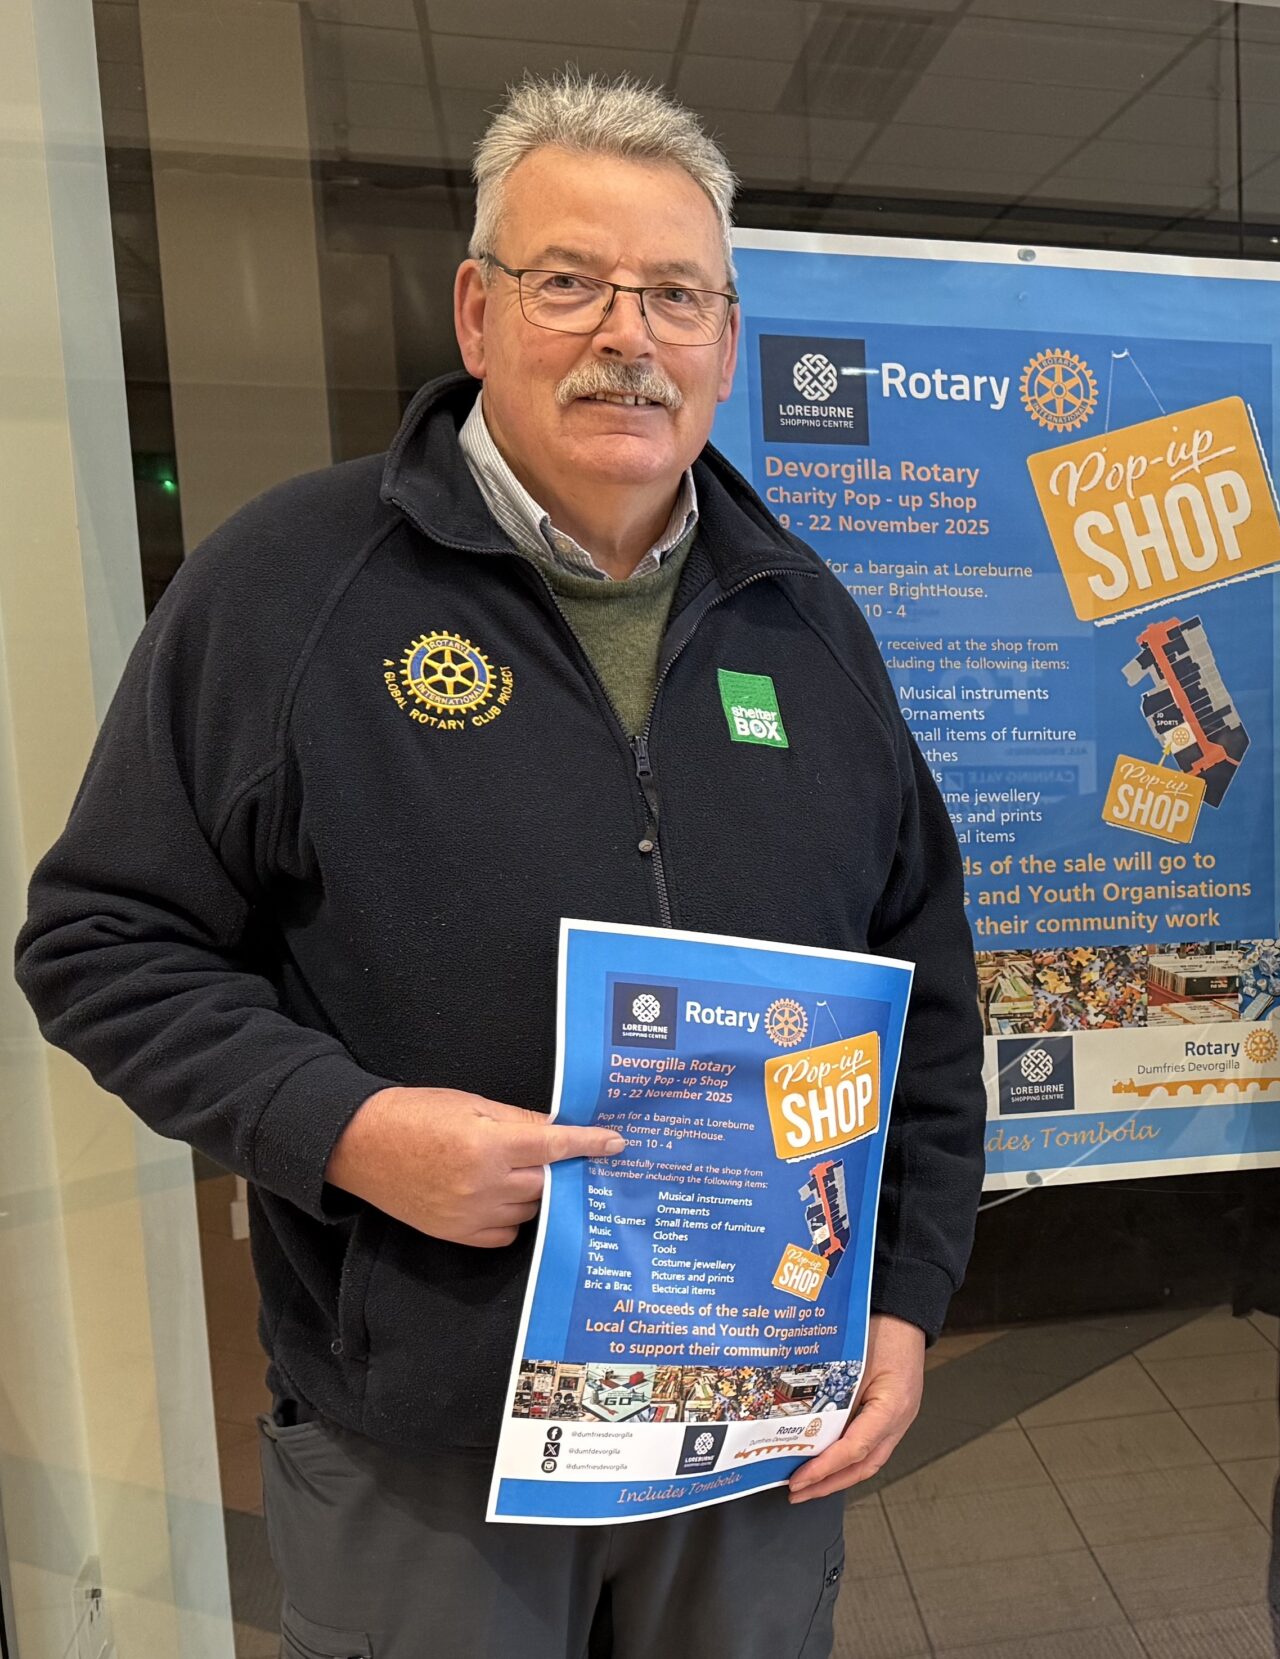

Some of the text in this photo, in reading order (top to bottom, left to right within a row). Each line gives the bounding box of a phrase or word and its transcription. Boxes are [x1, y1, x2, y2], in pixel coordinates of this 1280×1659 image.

[1041, 355, 1076, 368] ROTARY
[881, 363, 1010, 410] Rotary
[779, 404, 854, 418] LOREBURNE
[1033, 401, 1088, 424] INTERNATIONAL
[780, 418, 854, 429] SHOPPING CENTRE
[765, 456, 980, 488] Devorgilla Rotary
[1049, 426, 1236, 507] Pop-up
[766, 487, 837, 509] Charity
[844, 489, 881, 511] Pop
[898, 495, 923, 512] up
[929, 491, 977, 513] Shop
[775, 515, 791, 530] 9
[808, 514, 833, 531] 22
[838, 515, 939, 534] November
[945, 518, 989, 535] 2025
[1073, 470, 1251, 600] SHOP
[854, 563, 864, 575] a
[869, 560, 928, 578] bargain
[934, 564, 949, 576] at
[955, 563, 1032, 577] Loreburne
[889, 583, 987, 600] BrightHouse.
[865, 605, 882, 617] 10
[896, 604, 907, 617] 4
[428, 640, 468, 654] ROTARY
[384, 671, 408, 710] GLOBAL
[409, 708, 465, 730] ROTARY
[471, 705, 502, 727] CLUB
[497, 666, 513, 706] PROJECT
[416, 683, 484, 705] INTERNATIONAL
[900, 686, 1049, 700] Musical instruments
[731, 705, 777, 721] shelter
[900, 707, 985, 721] Ornaments
[734, 716, 782, 741] BOX
[912, 727, 1076, 741] mall items of furniture
[1120, 762, 1194, 796] Pop-up
[974, 788, 1040, 806] jewellery
[1112, 783, 1190, 833] SHOP
[967, 809, 995, 824] and
[1001, 810, 1042, 826] prints
[976, 829, 1015, 843] items
[989, 855, 1013, 875] of
[1018, 854, 1057, 874] the
[1064, 853, 1106, 873] sale
[1113, 851, 1152, 872] will
[1159, 855, 1187, 875] go
[1193, 852, 1216, 869] to
[978, 884, 1020, 906] and
[1028, 882, 1095, 904] Youth
[1103, 879, 1251, 905] Organisations
[975, 907, 1220, 936] their community work
[685, 1001, 760, 1033] Rotary
[622, 1024, 668, 1034] LOREBURNE
[1184, 1041, 1240, 1057] Rotary
[610, 1054, 736, 1076] Devorgilla Rotary
[773, 1046, 872, 1091] Pop-up
[1137, 1060, 1240, 1075] Dumfries Devorgilla
[1010, 1084, 1064, 1096] LOREBURNE
[1011, 1093, 1064, 1103] SHOPPING CENTRE
[781, 1073, 873, 1148] SHOP
[1040, 1118, 1160, 1149] Tombola
[588, 1185, 613, 1197] Books
[588, 1198, 606, 1210] Toys
[589, 1212, 646, 1225] Board Games
[588, 1225, 612, 1236] Music
[588, 1238, 619, 1250] Jigsaws
[587, 1251, 604, 1262] TVs
[586, 1265, 632, 1278] Tableware
[779, 1262, 820, 1295] SHOP
[584, 1280, 603, 1289] Bric
[614, 1281, 632, 1291] Brac
[617, 1472, 742, 1504] Includes Tombola
